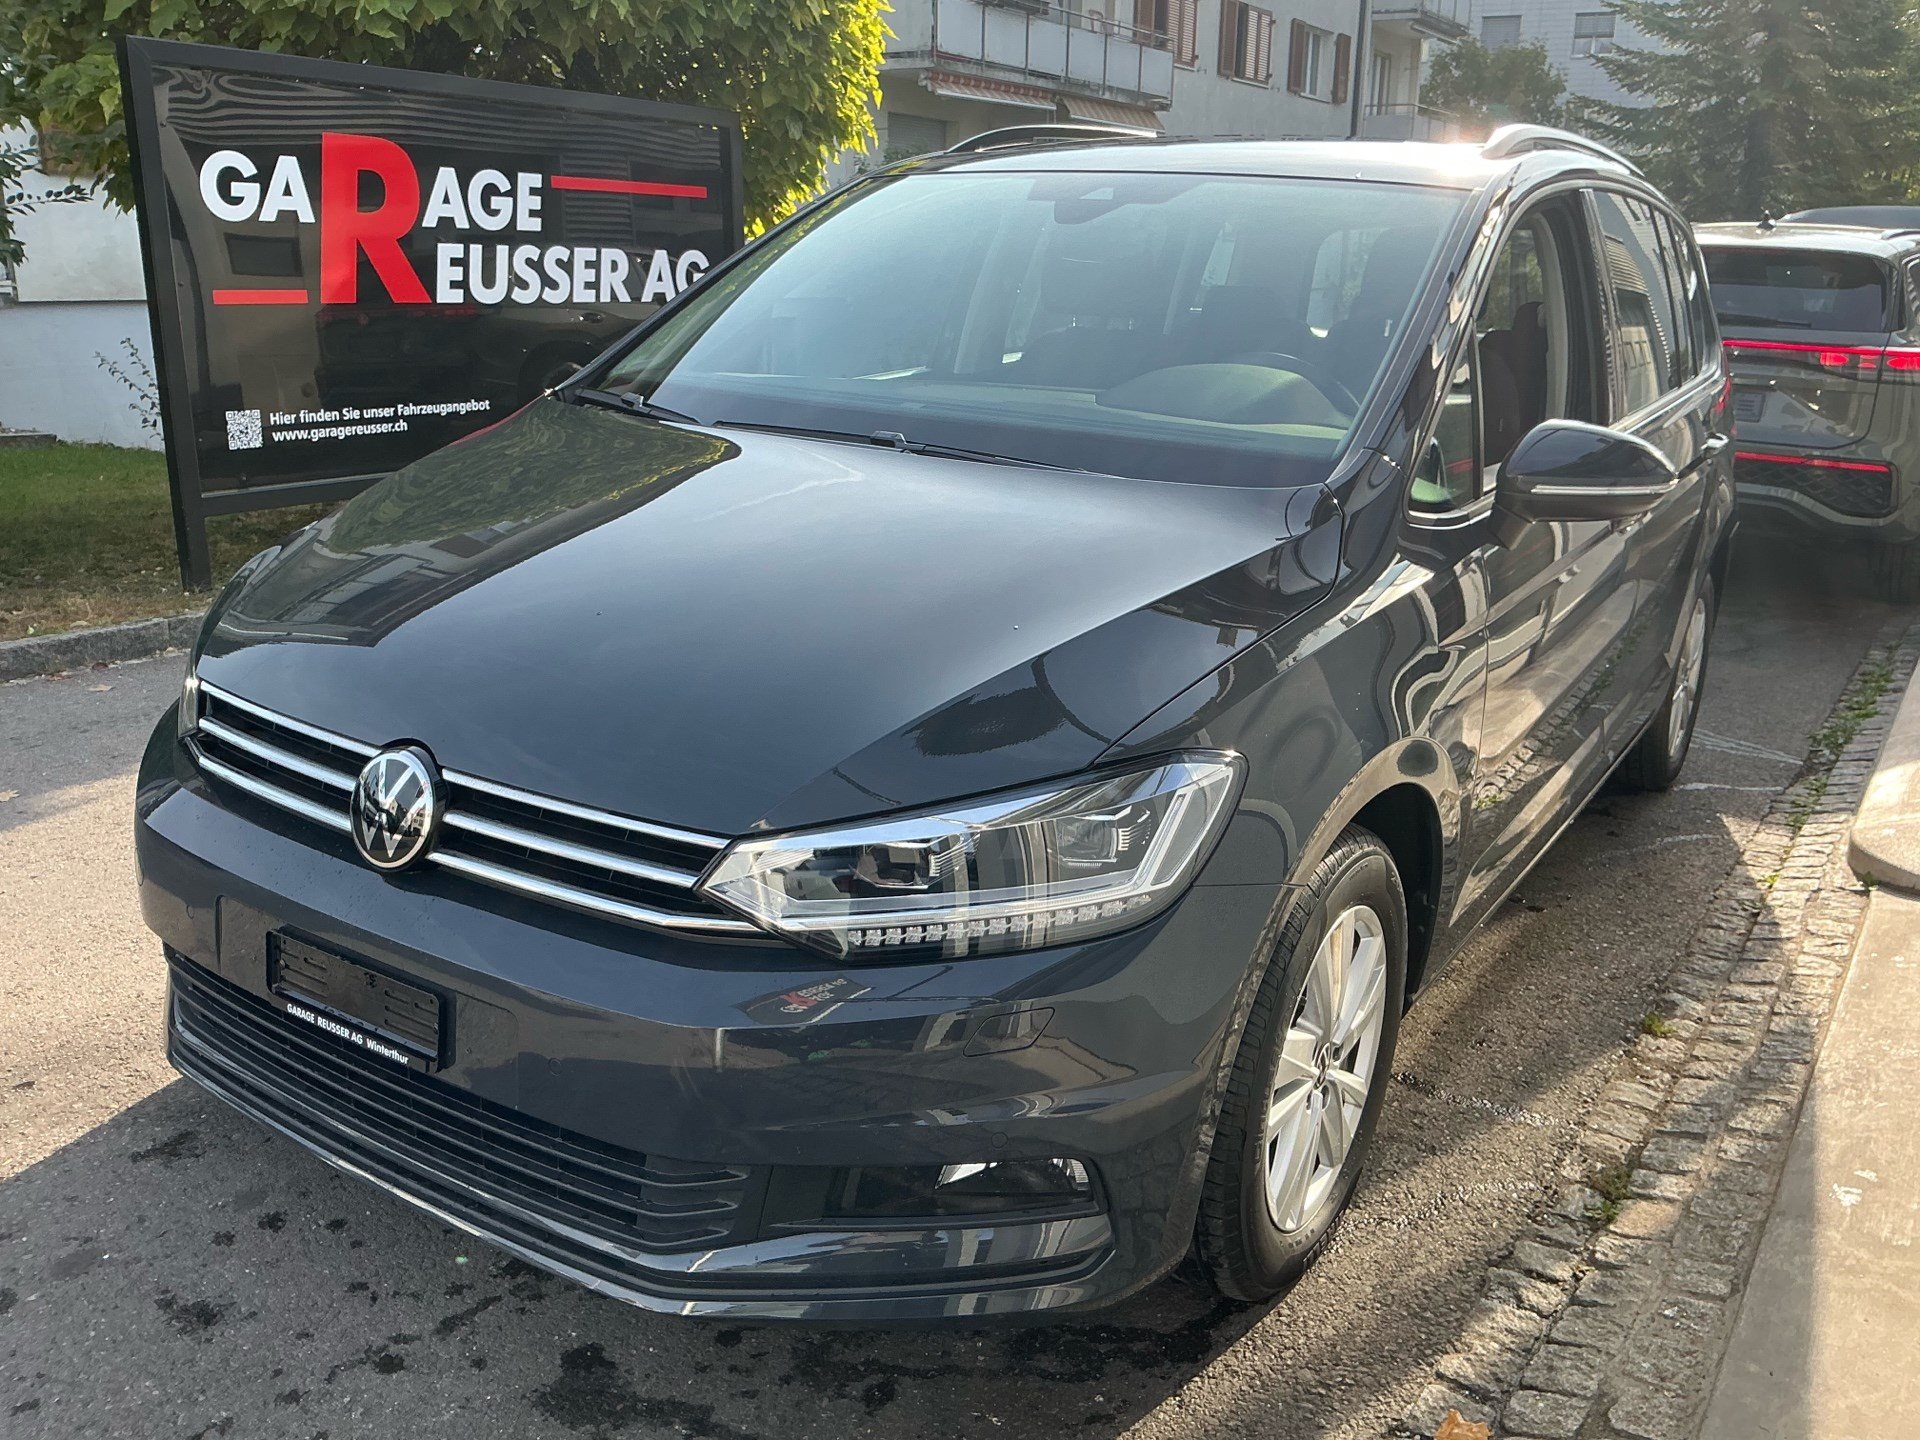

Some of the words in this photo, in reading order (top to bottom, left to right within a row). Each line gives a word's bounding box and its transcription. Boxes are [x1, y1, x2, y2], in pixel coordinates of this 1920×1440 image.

[199, 131, 543, 305] GARAGE
[641, 249, 710, 303] AG
[269, 412, 296, 425] Hier
[299, 407, 340, 422] finden
[342, 404, 360, 420] Sie
[363, 405, 395, 419] unser
[396, 399, 491, 416] Fahrzeugangebot
[271, 419, 408, 441] www.garagereusser.ch
[287, 1003, 315, 1024] GARAGE
[317, 1016, 350, 1040] REUSSER
[350, 1032, 364, 1045] AG
[366, 1038, 409, 1065] Winterthur
